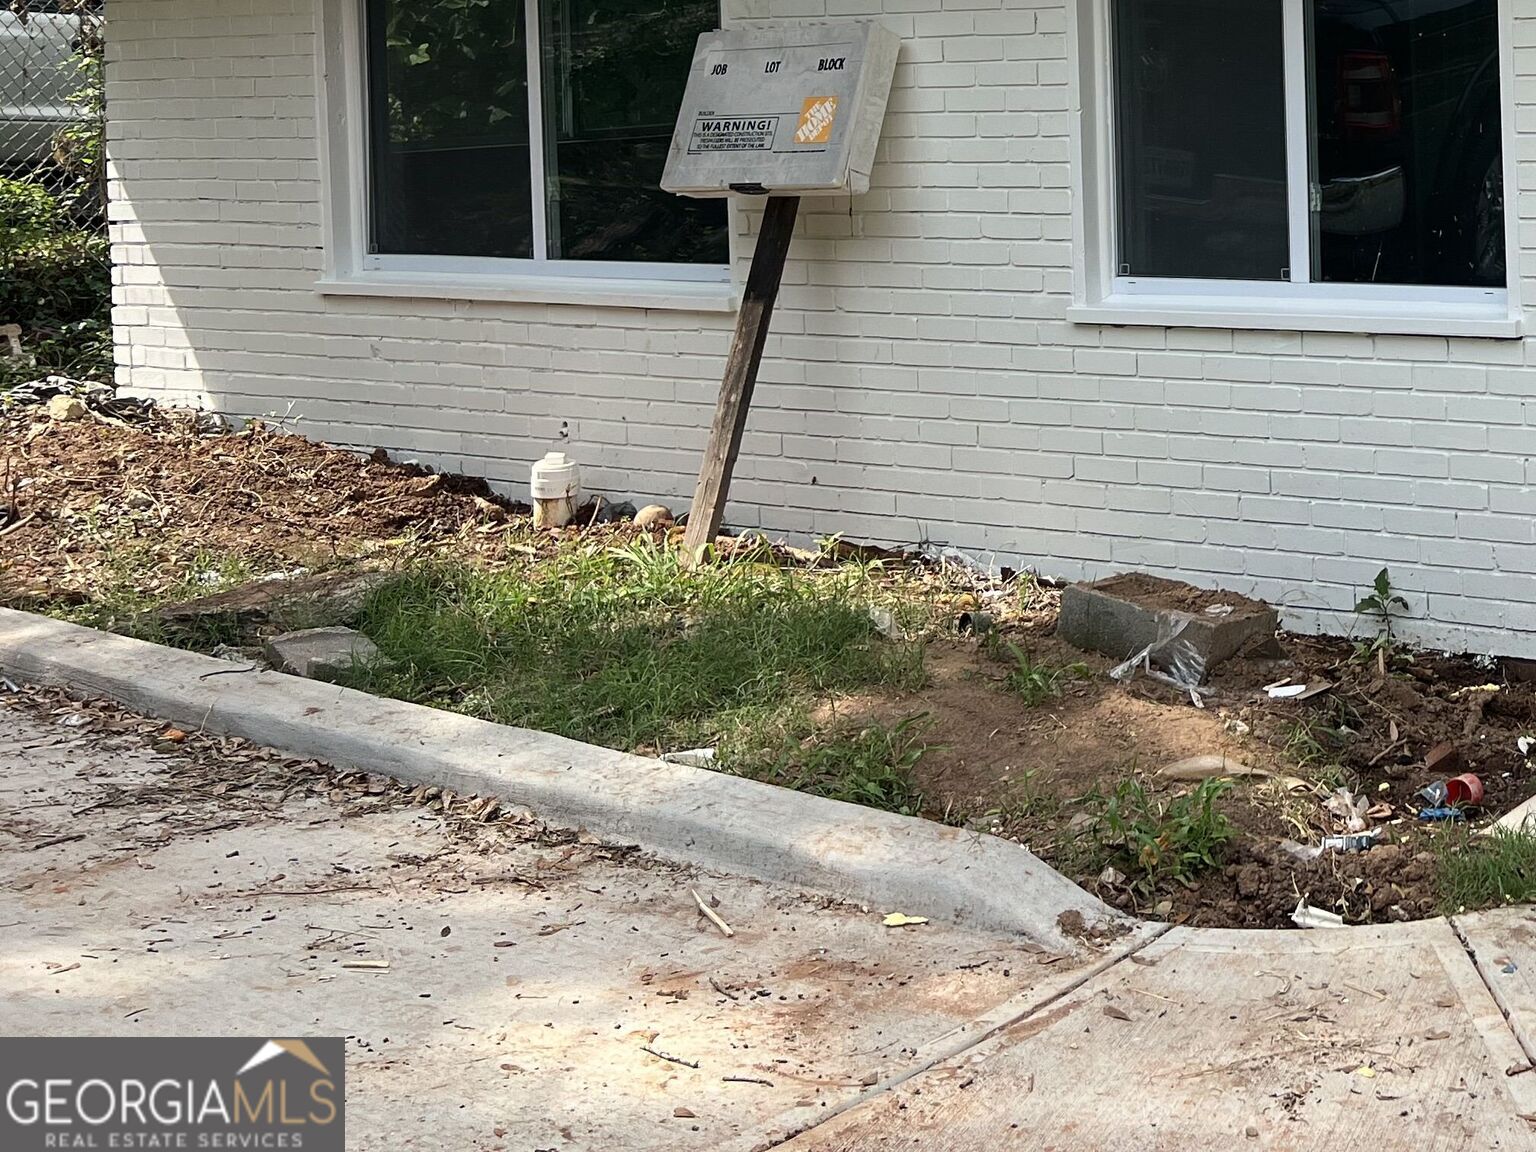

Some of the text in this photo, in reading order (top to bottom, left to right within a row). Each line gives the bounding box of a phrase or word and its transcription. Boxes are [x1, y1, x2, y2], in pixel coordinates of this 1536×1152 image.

[711, 57, 846, 76] JOB LOT BLOCK
[702, 120, 772, 132] WARNING!
[797, 97, 837, 142] HOME
